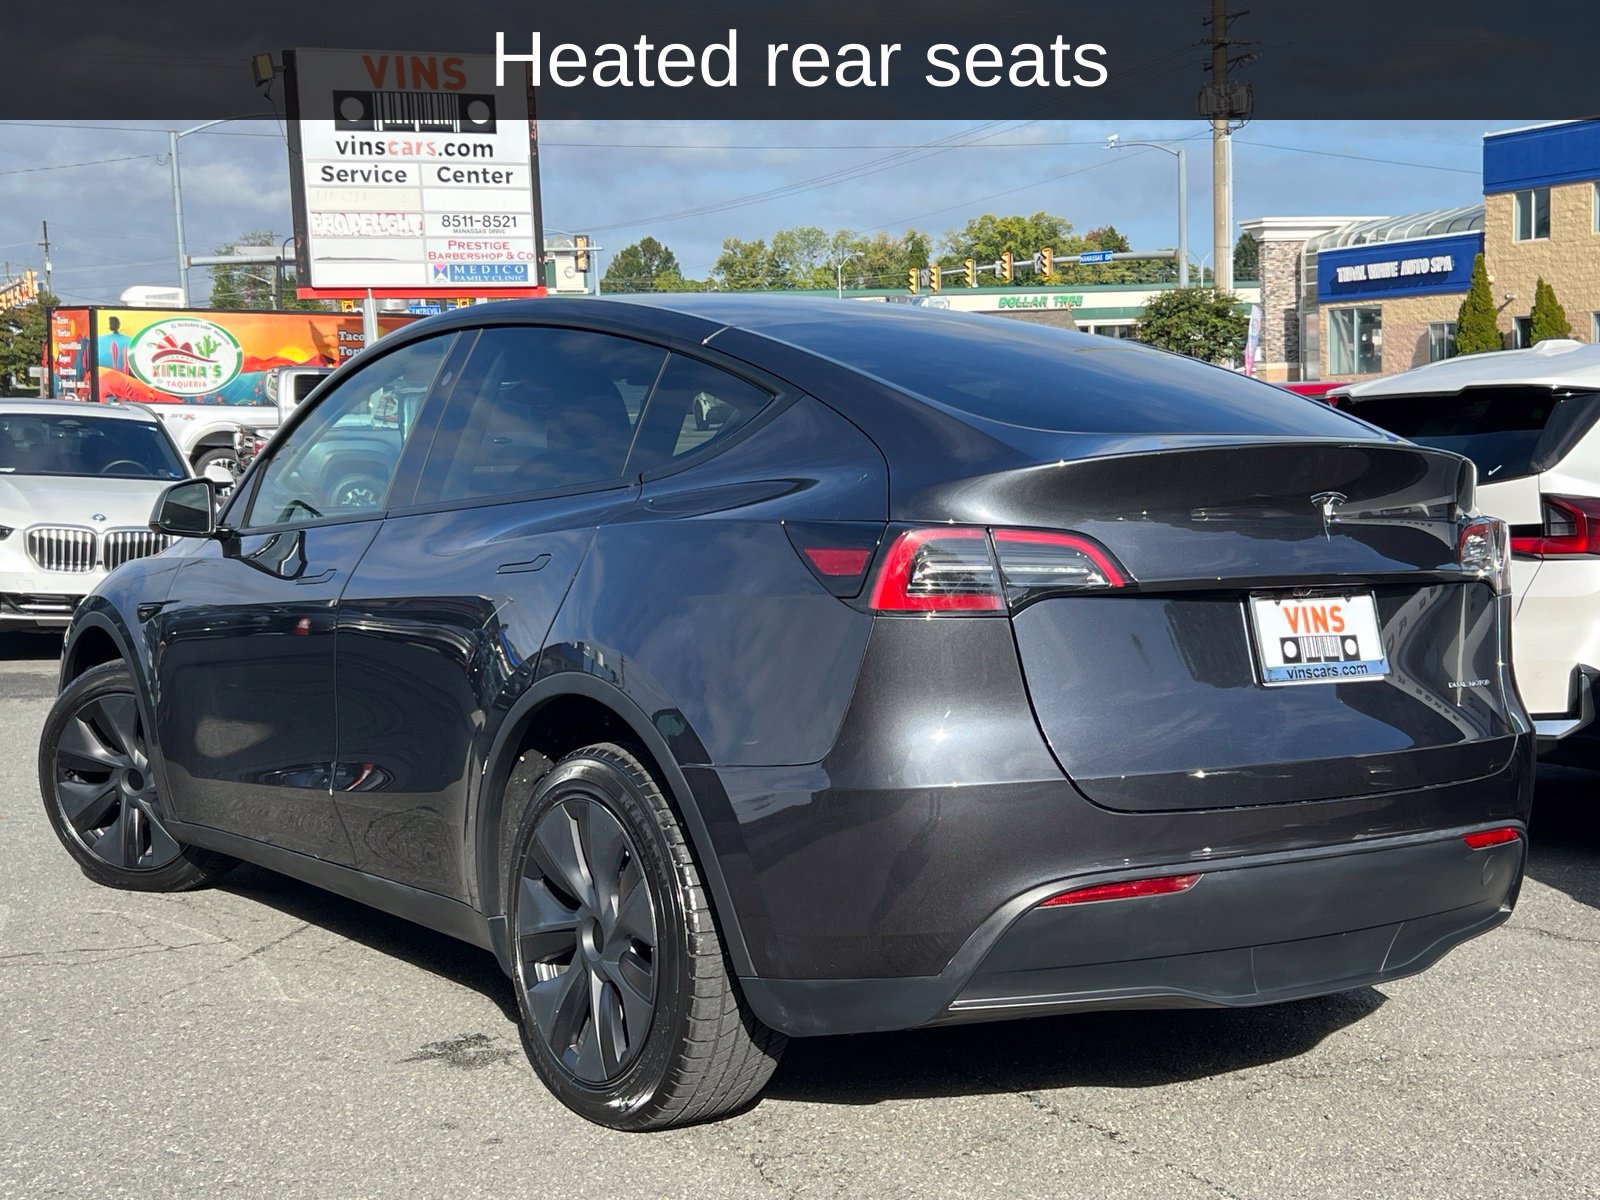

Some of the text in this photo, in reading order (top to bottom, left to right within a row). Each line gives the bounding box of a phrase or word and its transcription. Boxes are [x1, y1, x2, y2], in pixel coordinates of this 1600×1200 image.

[362, 54, 467, 91] VINS
[335, 135, 494, 158] vinscars.com
[321, 164, 514, 184] Service Center
[441, 214, 517, 228] 8511-8521
[447, 240, 511, 250] PRESTIGE
[428, 251, 504, 260] BARBERSHOP
[506, 252, 515, 260] &
[454, 265, 525, 274] MEDICO
[1336, 265, 1367, 283] TIDAL
[1400, 257, 1429, 276] AUTO
[1430, 255, 1453, 273] SPA
[998, 296, 1048, 309] DOLLAR
[338, 331, 364, 342] Taco
[152, 364, 222, 379] XIMENA'S
[166, 380, 207, 389] TAQUERIA
[1282, 605, 1345, 634] VINS
[1286, 663, 1369, 680] vinscars.com
